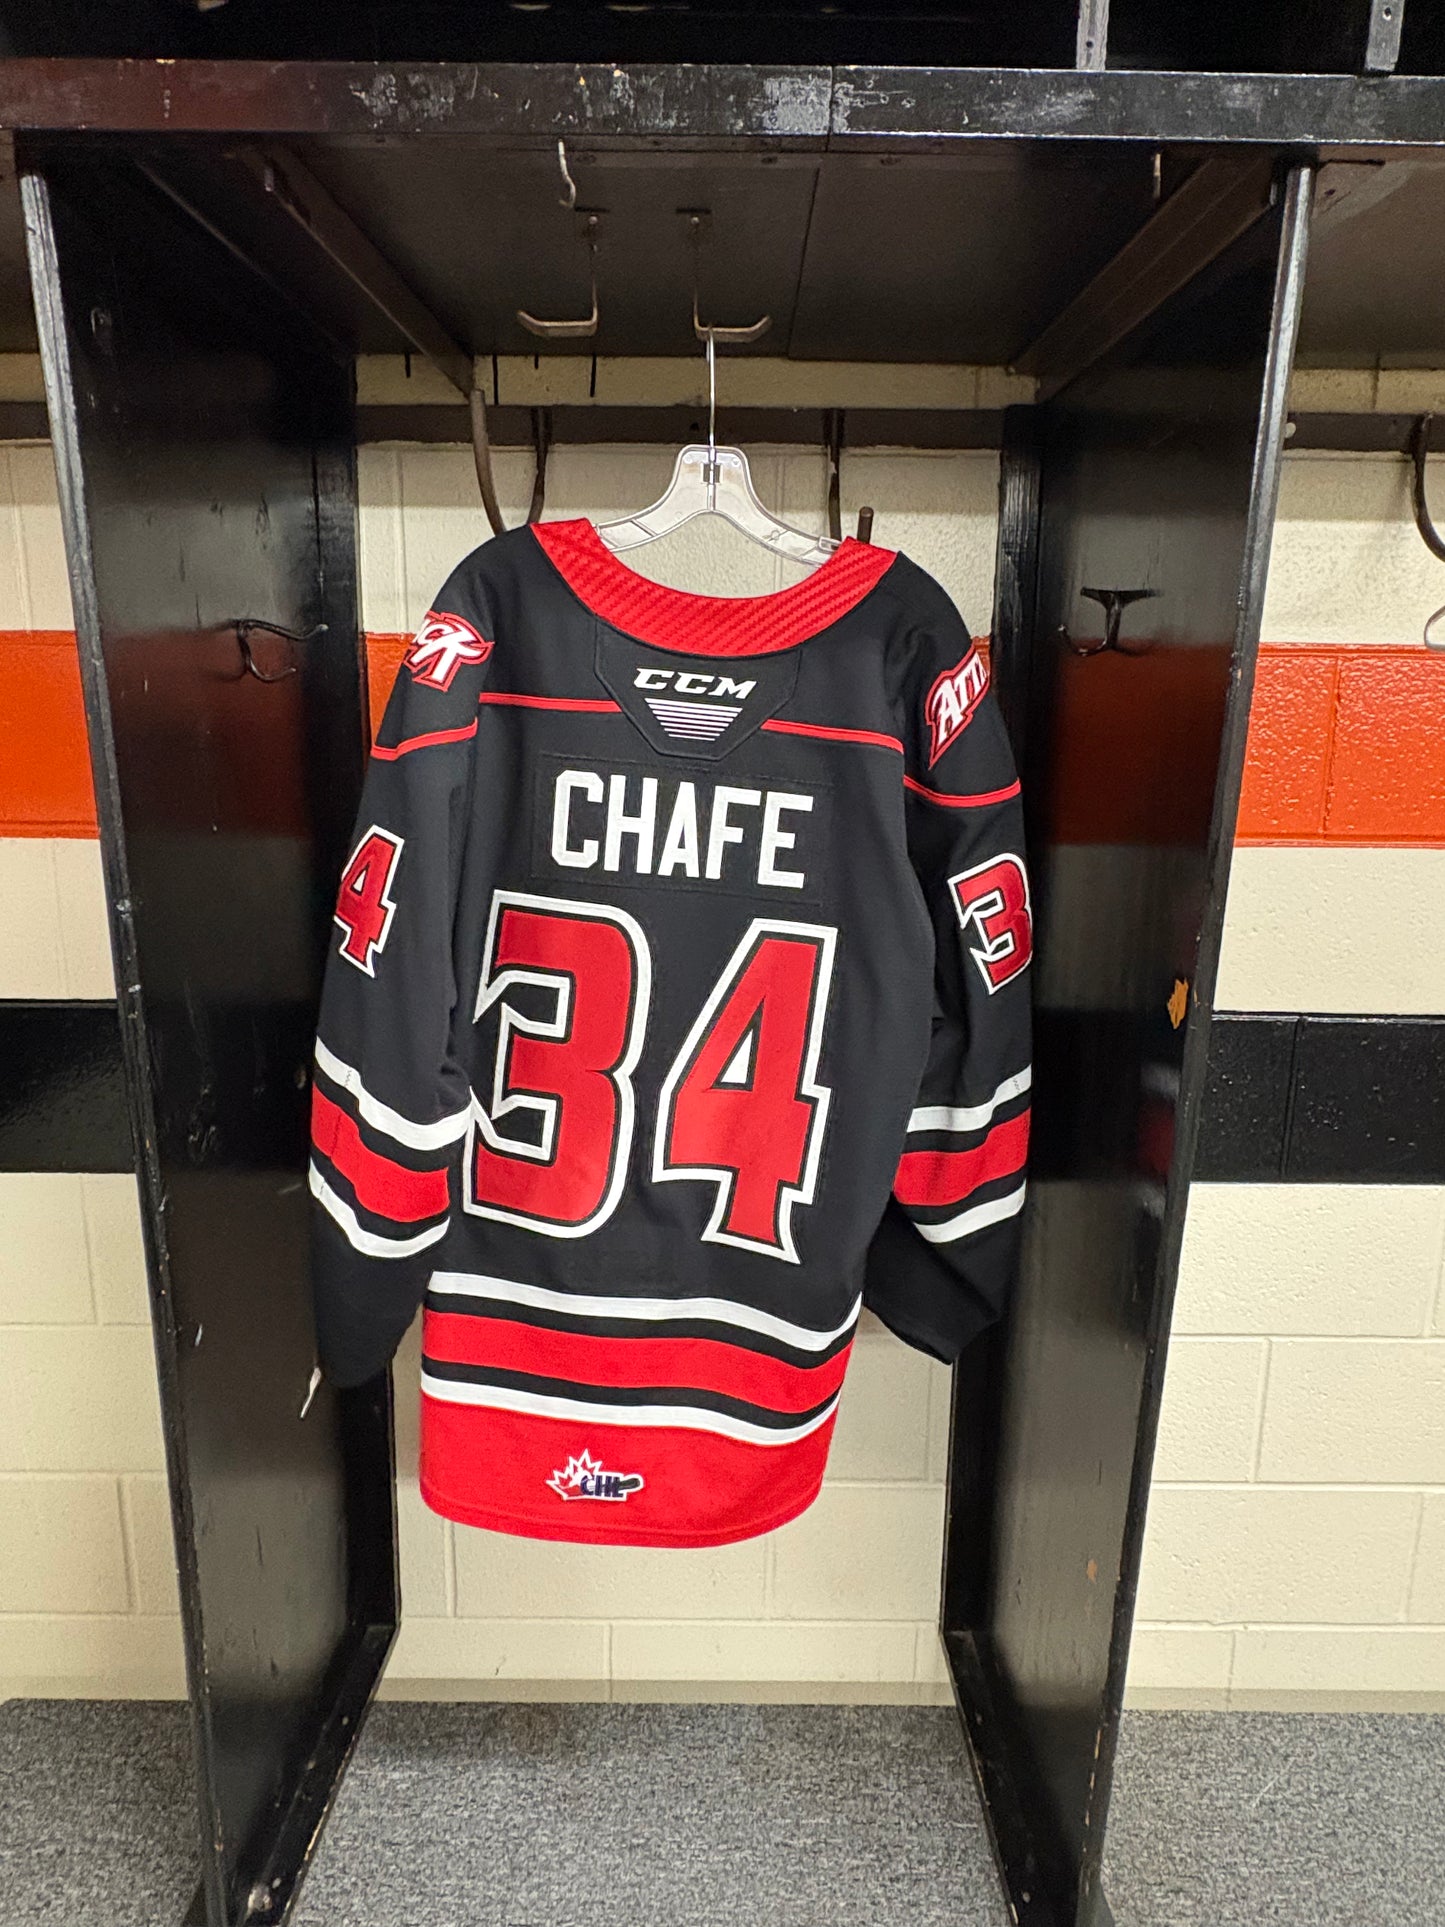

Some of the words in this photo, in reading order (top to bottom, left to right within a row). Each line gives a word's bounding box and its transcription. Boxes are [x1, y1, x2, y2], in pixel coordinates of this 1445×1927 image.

[633, 667, 758, 699] CCM
[551, 769, 814, 889] CHAFE
[333, 823, 405, 979] 4
[947, 852, 1034, 996] 3
[463, 889, 838, 1265] 34
[579, 1474, 625, 1498] CHL
